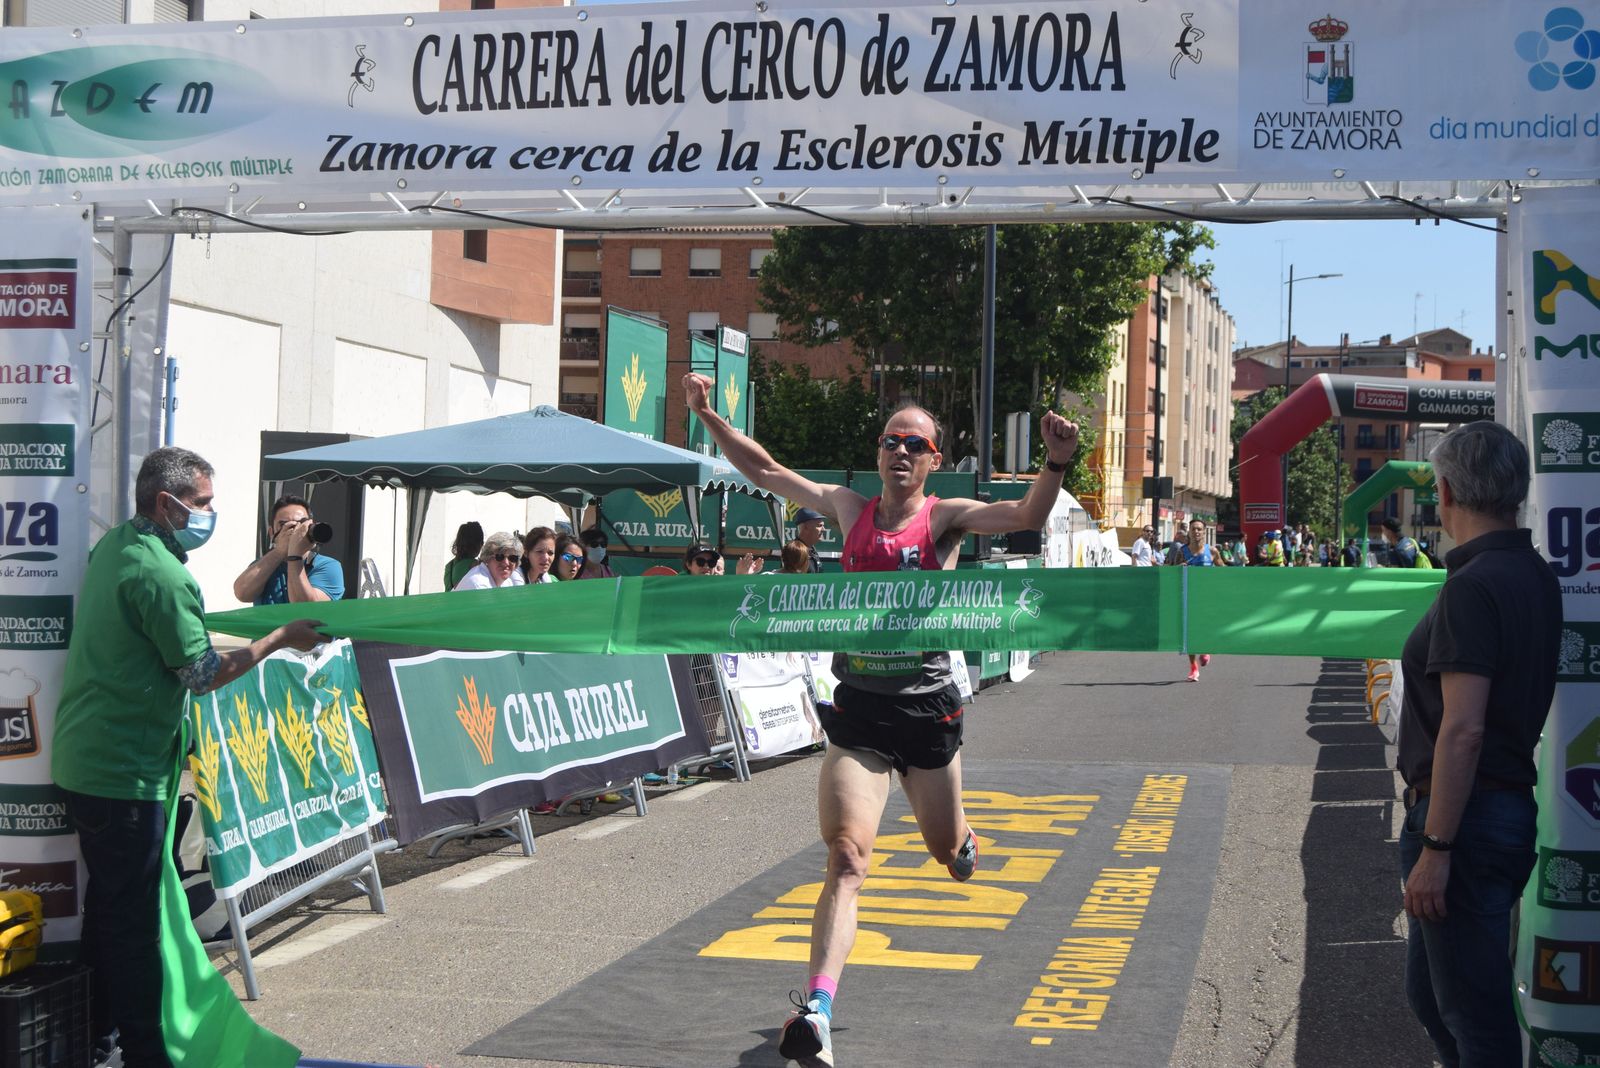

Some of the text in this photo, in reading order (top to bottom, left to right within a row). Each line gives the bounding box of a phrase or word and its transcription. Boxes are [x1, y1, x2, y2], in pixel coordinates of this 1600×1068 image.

[411, 11, 1126, 115] CARRERA del CERCO de ZAMORA
[1254, 109, 1403, 128] AYUNTAMIENTO
[1429, 116, 1467, 140] dia
[1474, 113, 1576, 139] mundial
[320, 117, 1220, 174] Zamora cerca de la Esclerosis Múltiple
[1253, 128, 1403, 150] DE ZAMORA
[38, 165, 114, 185] ZAMORANA
[120, 163, 139, 181] DE
[146, 161, 223, 180] ESCLEROSIS
[230, 156, 294, 177] MÚLTIPLE
[49, 284, 68, 295] DE
[0, 298, 69, 317] MORA
[1367, 397, 1404, 407] ZAMORA
[1418, 388, 1446, 400] CON
[1450, 389, 1463, 400] EL
[1418, 403, 1478, 415] GANAMOS
[15, 458, 66, 470] RURAL
[613, 522, 650, 536] CAJA
[736, 526, 773, 541] CAJA
[4, 567, 14, 578] de
[16, 566, 59, 578] Zamora
[1560, 581, 1600, 594] anade
[768, 580, 1004, 613] CARRERA del CERCO de ZAMORA
[767, 612, 1002, 633] Zamora cerca de la Esclerosis Múltiple
[15, 632, 64, 643] RURAL
[867, 662, 885, 671] CAJA
[504, 679, 648, 753] CAJA RURAL
[15, 817, 67, 830] RURAL
[1071, 866, 1160, 930] INTEGRAL
[1013, 937, 1135, 1031] REFORMA
